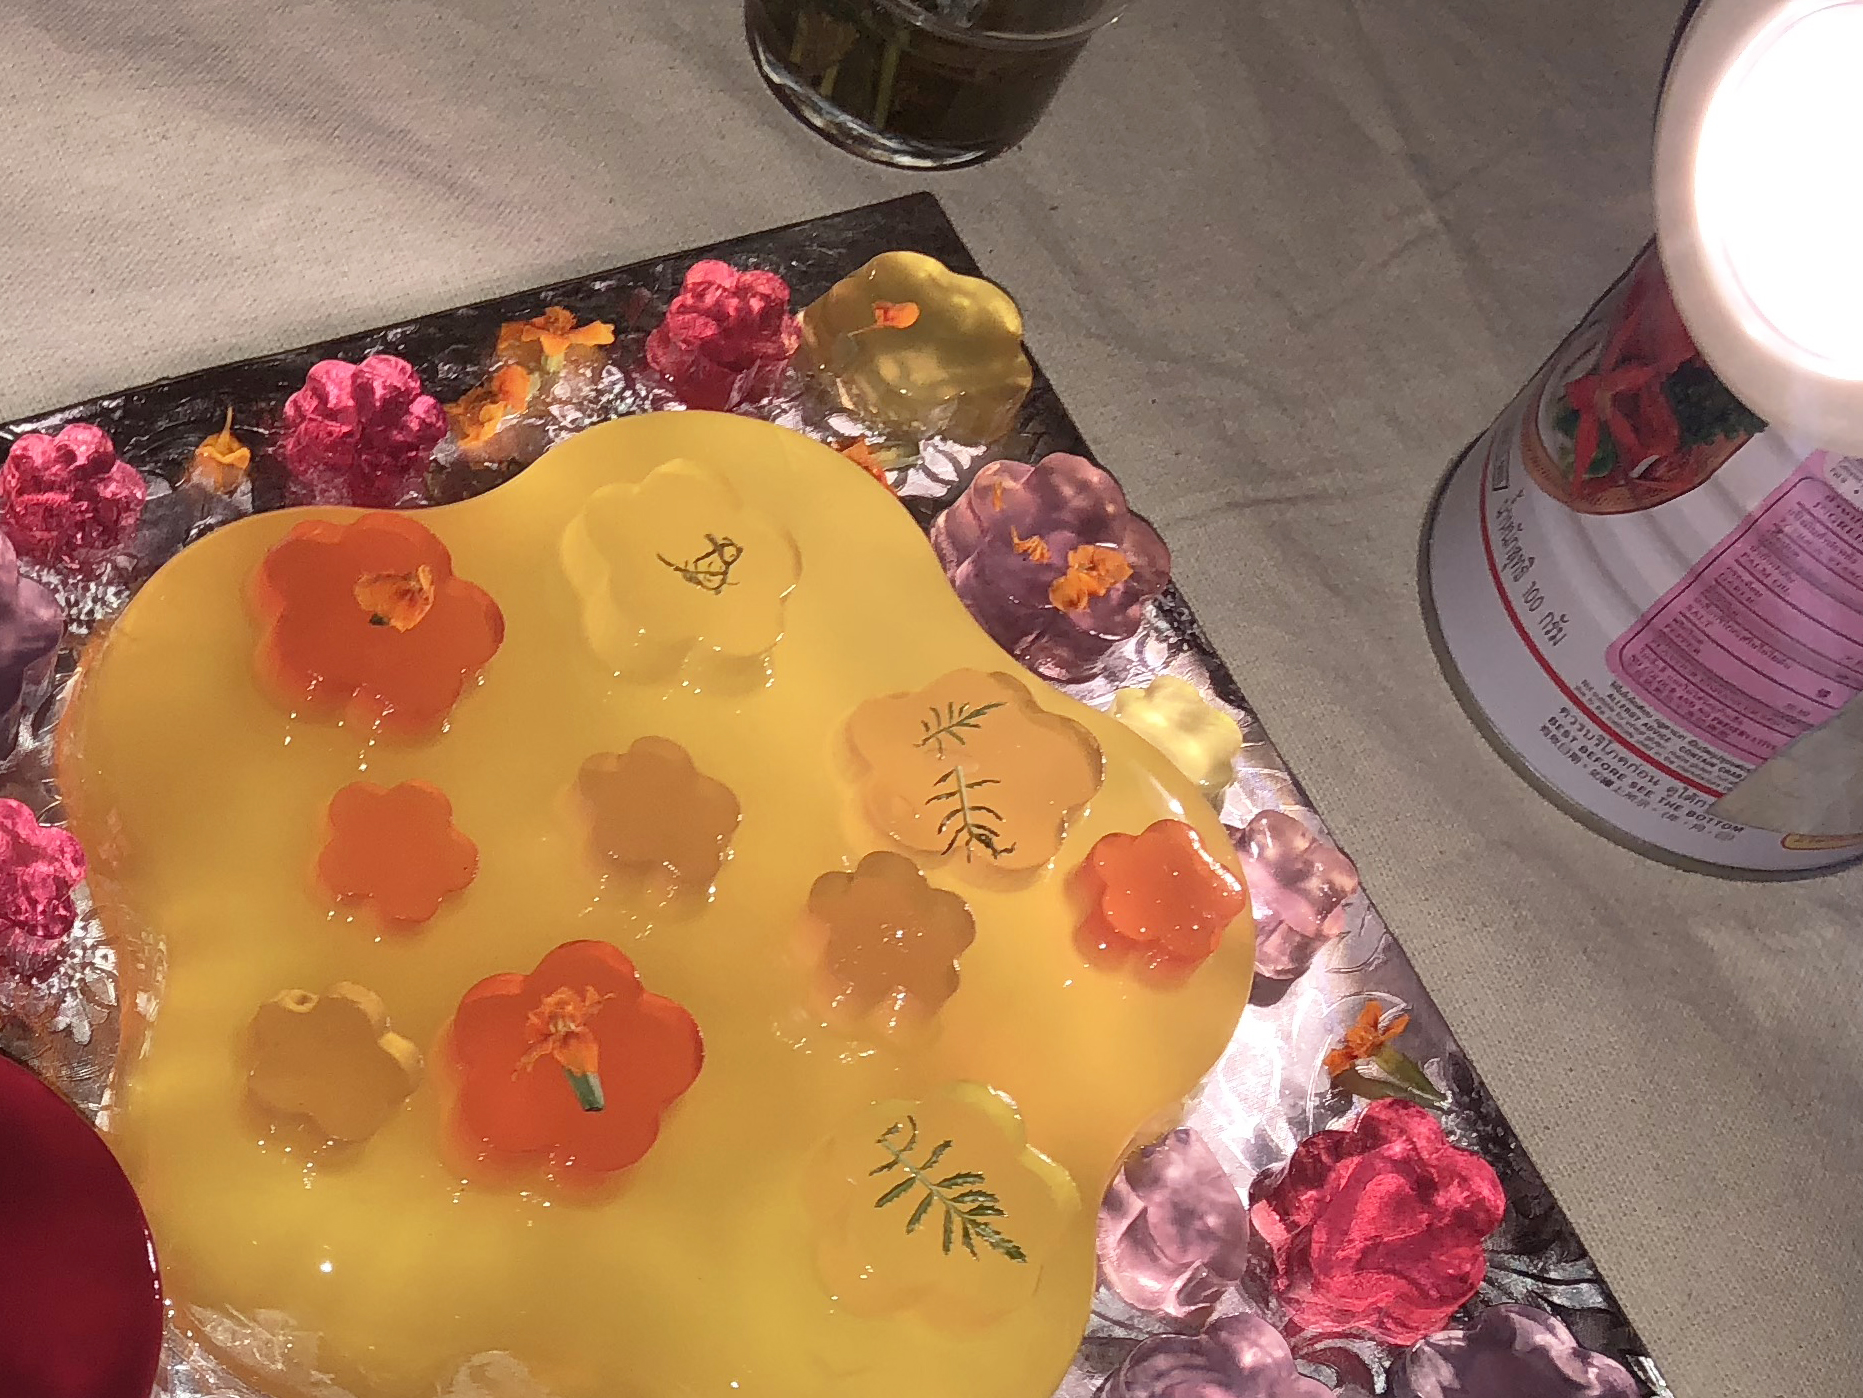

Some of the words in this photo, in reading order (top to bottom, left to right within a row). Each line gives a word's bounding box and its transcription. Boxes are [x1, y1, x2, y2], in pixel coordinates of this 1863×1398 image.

[1521, 579, 1547, 613] 100
[1536, 610, 1570, 648] กรัม
[1683, 603, 1713, 629] SALT
[1605, 691, 1642, 722] ALLERGY
[1640, 720, 1672, 744] ADVICE
[1677, 743, 1718, 769] CONTAIN
[1545, 714, 1580, 744] BEST
[1576, 742, 1628, 783] BEFORE
[1627, 777, 1655, 799] SEE
[1656, 794, 1685, 814] THE
[1684, 808, 1745, 835] BOTTOM
